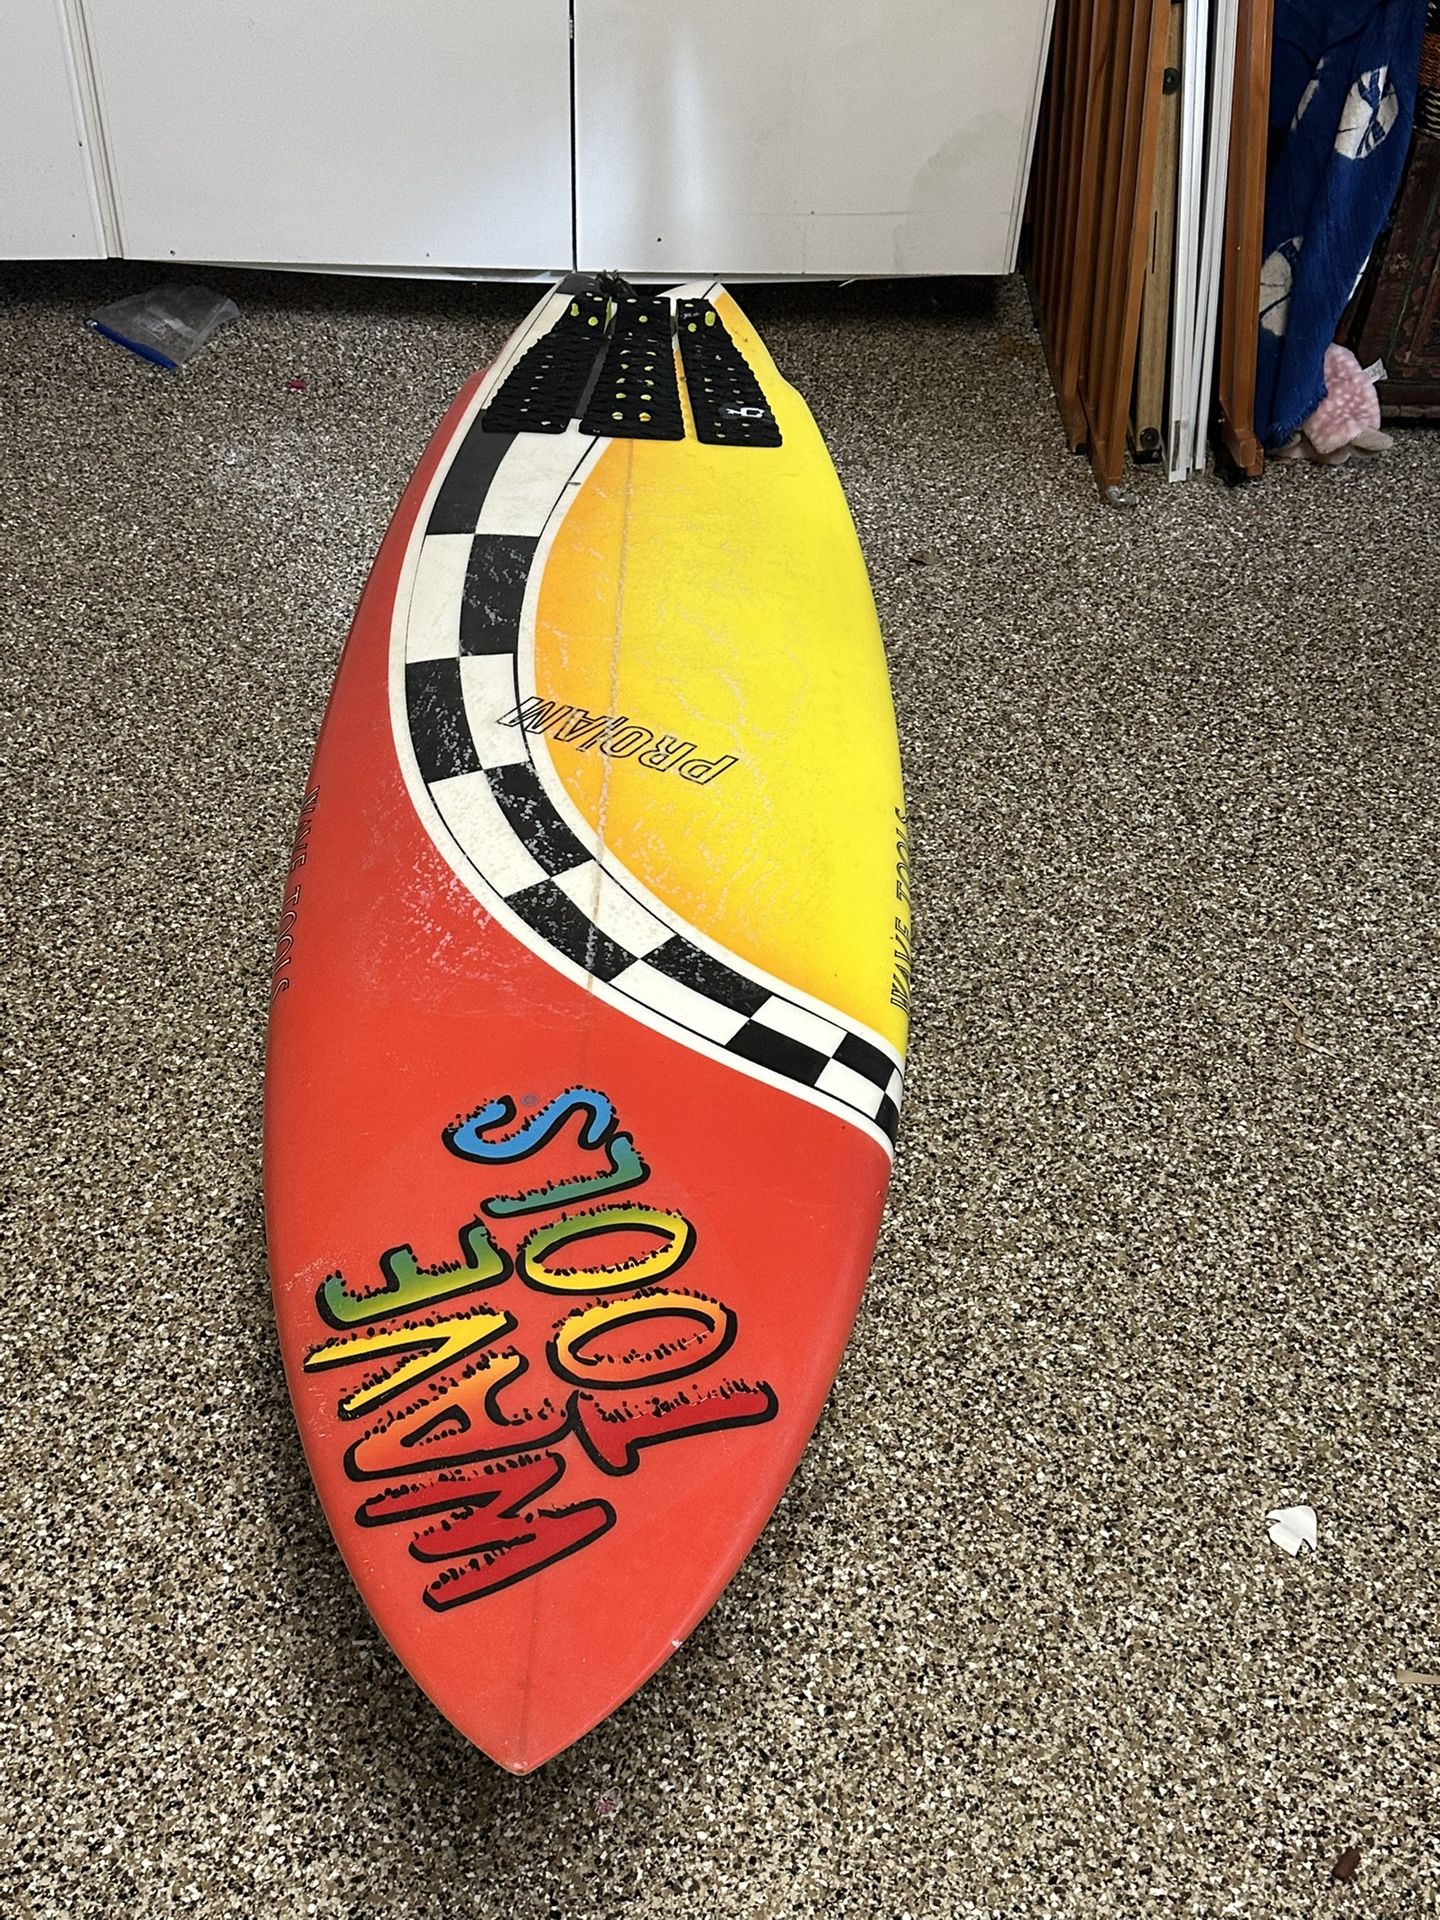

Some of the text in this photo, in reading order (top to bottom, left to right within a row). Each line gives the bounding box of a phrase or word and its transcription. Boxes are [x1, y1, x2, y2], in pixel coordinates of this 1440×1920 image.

[890, 916, 911, 1016] WAVE
[303, 1214, 617, 1612] WAVE
[442, 1086, 779, 1476] TOOLS
